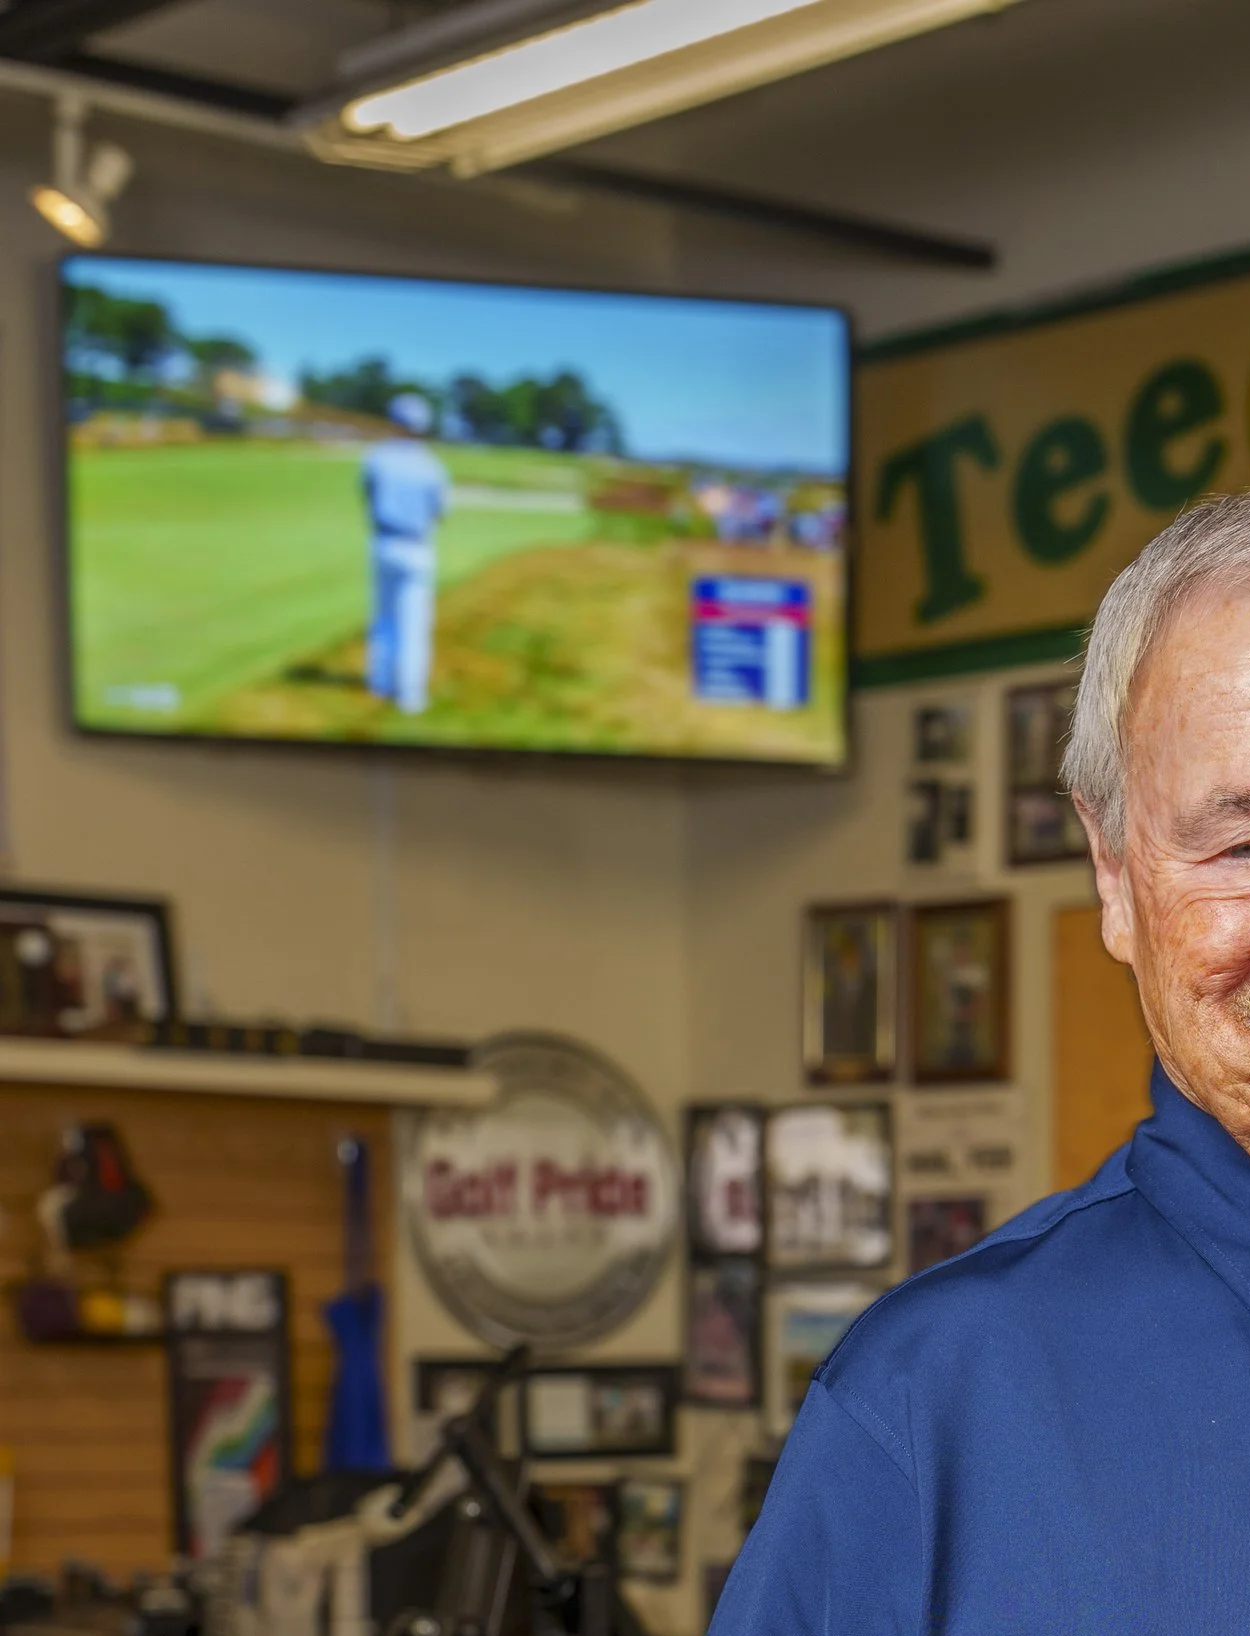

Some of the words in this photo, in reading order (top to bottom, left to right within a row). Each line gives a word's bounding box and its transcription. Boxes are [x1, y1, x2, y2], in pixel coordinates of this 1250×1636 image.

[875, 355, 1226, 623] Tee
[425, 1156, 518, 1220] Golf
[532, 1154, 651, 1218] Pride
